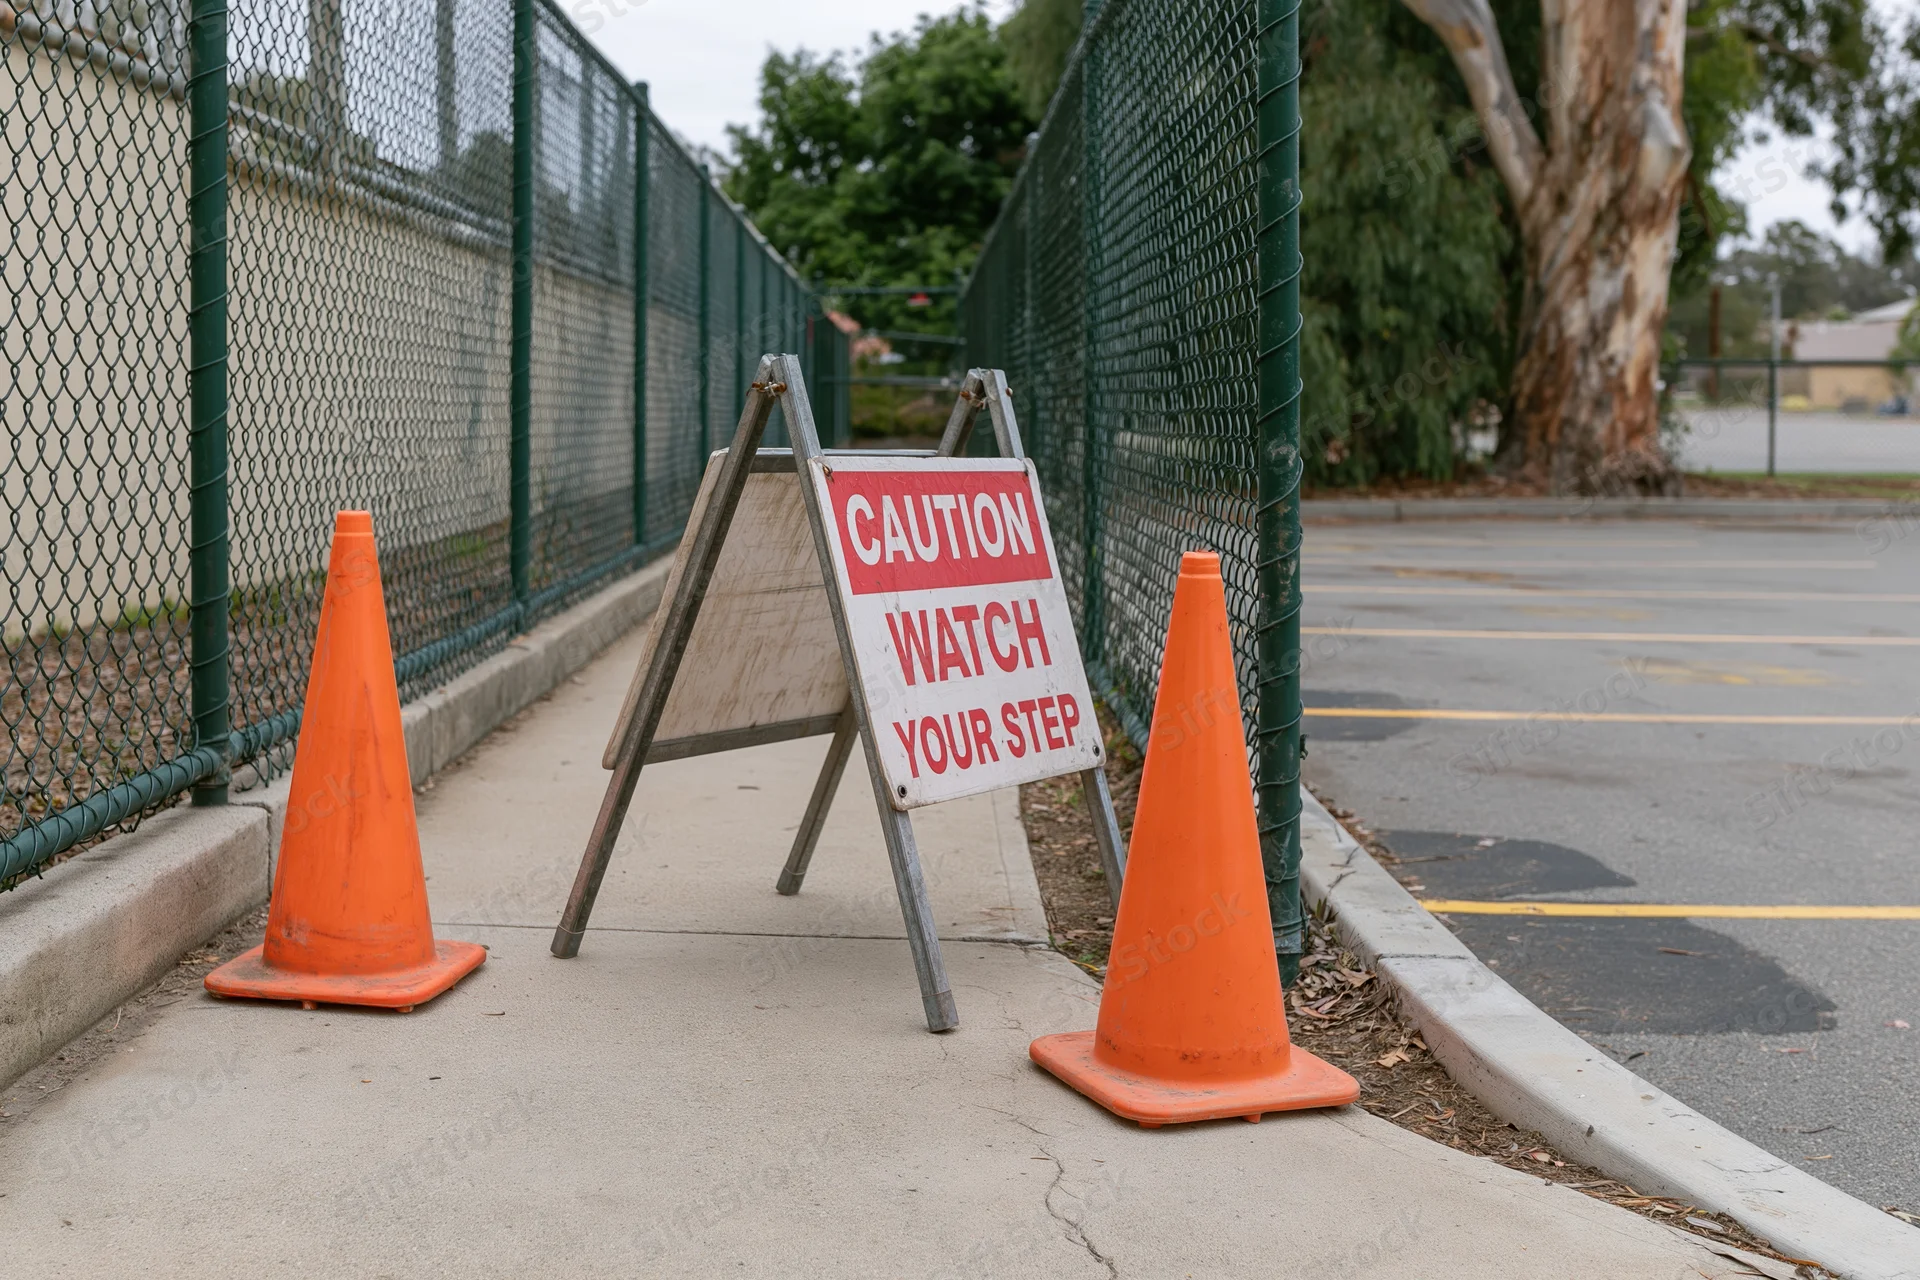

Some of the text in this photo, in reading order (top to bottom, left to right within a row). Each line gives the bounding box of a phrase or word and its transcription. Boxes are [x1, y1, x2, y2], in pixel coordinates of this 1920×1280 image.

[845, 492, 1037, 566] CAUTION
[885, 598, 1053, 686] WATCH
[892, 693, 1081, 779] YOUR STEP
